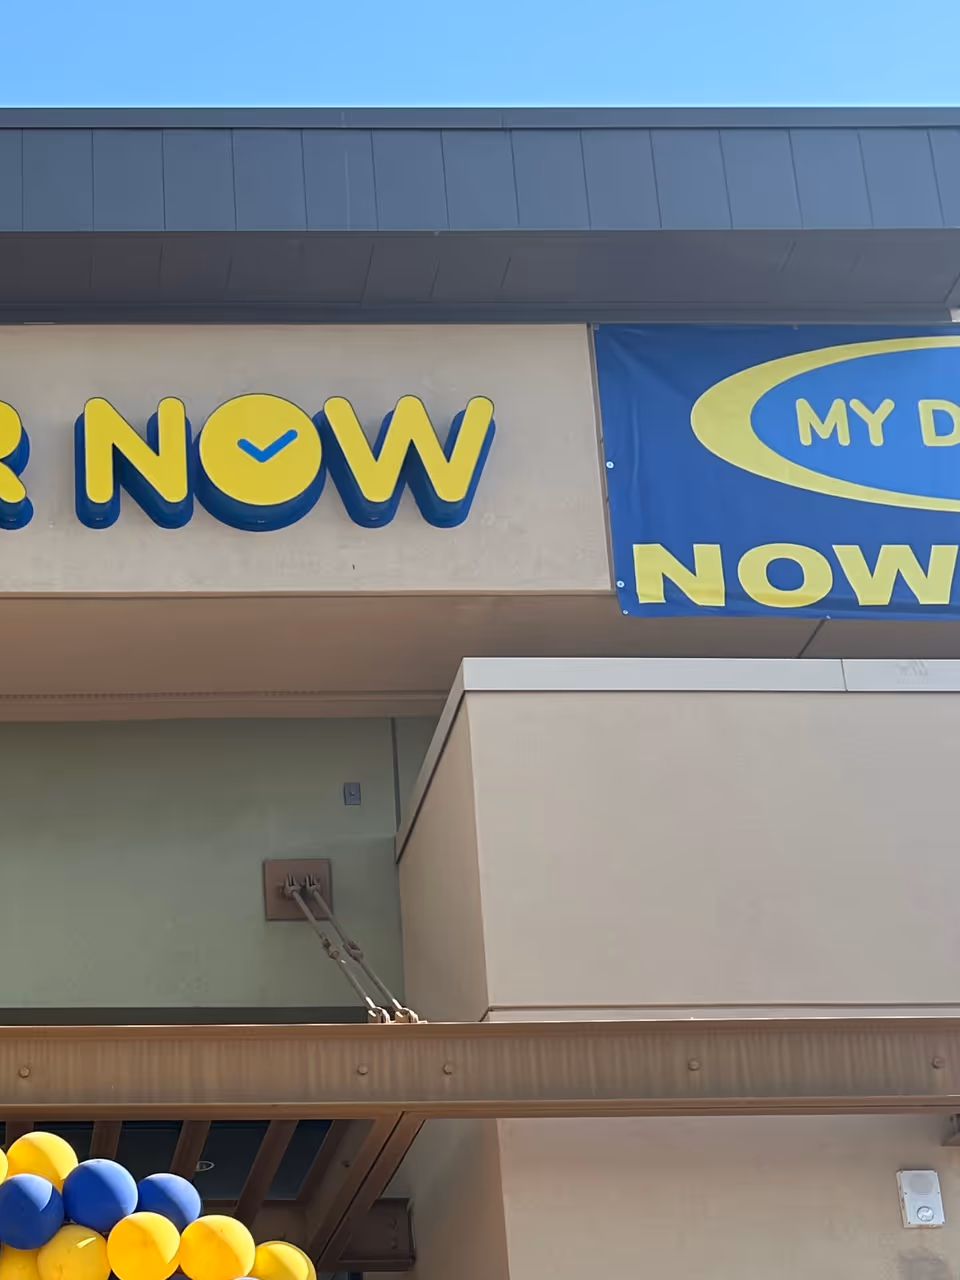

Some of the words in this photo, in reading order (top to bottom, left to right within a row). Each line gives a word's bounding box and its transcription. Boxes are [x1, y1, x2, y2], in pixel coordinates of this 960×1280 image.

[795, 398, 895, 446] MY
[74, 392, 496, 532] NOW
[633, 543, 959, 608] NOW
